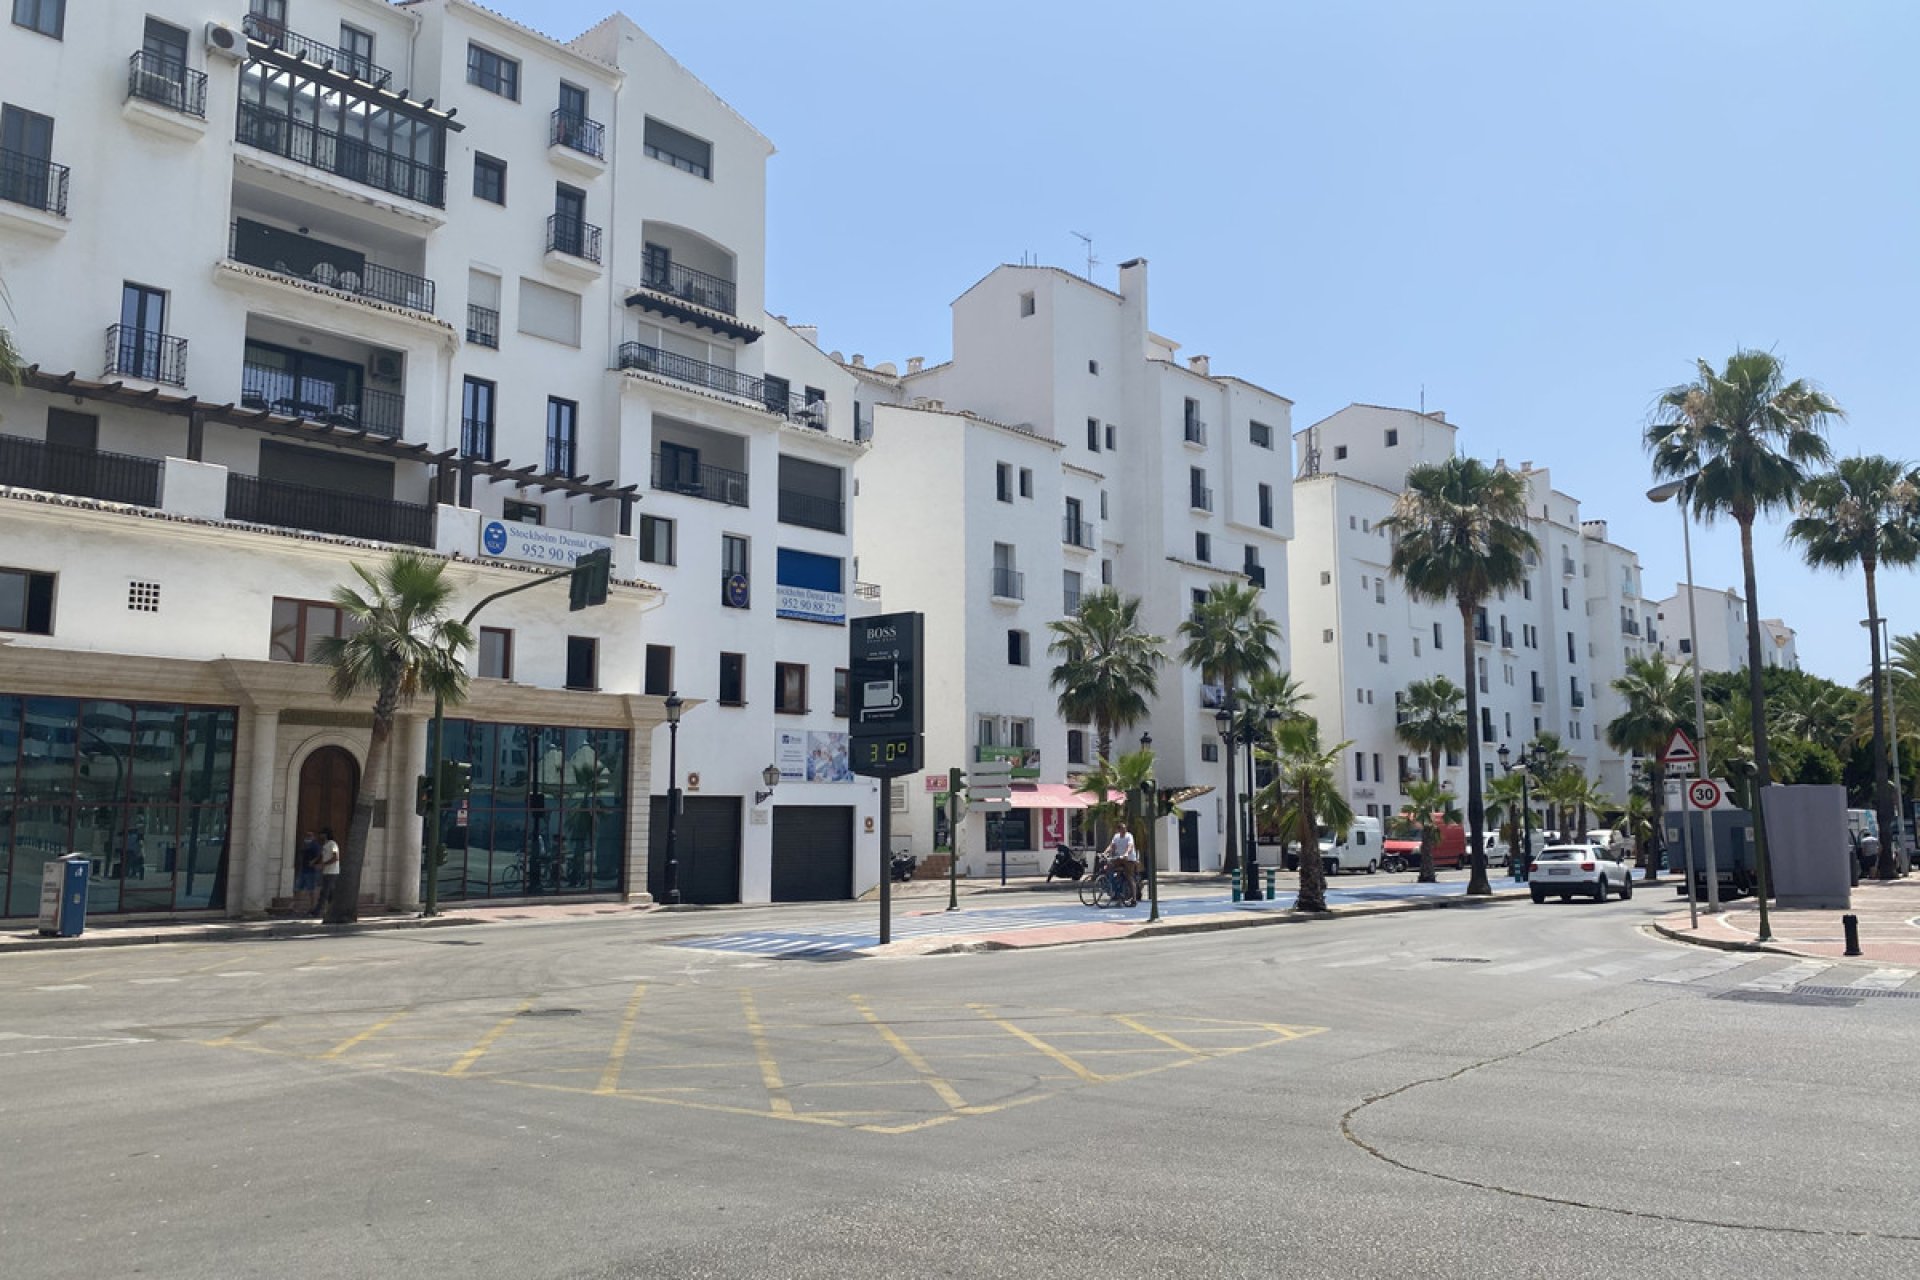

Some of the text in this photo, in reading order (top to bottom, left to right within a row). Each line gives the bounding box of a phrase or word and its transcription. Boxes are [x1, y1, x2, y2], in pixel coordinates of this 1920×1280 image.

[510, 527, 557, 542] Stockholm
[523, 544, 545, 558] 952
[549, 547, 563, 560] 90
[783, 598, 797, 608] 952
[800, 600, 811, 610] 90
[825, 603, 835, 613] 22
[867, 625, 896, 639] BOSS
[1696, 789, 1713, 800] 30
